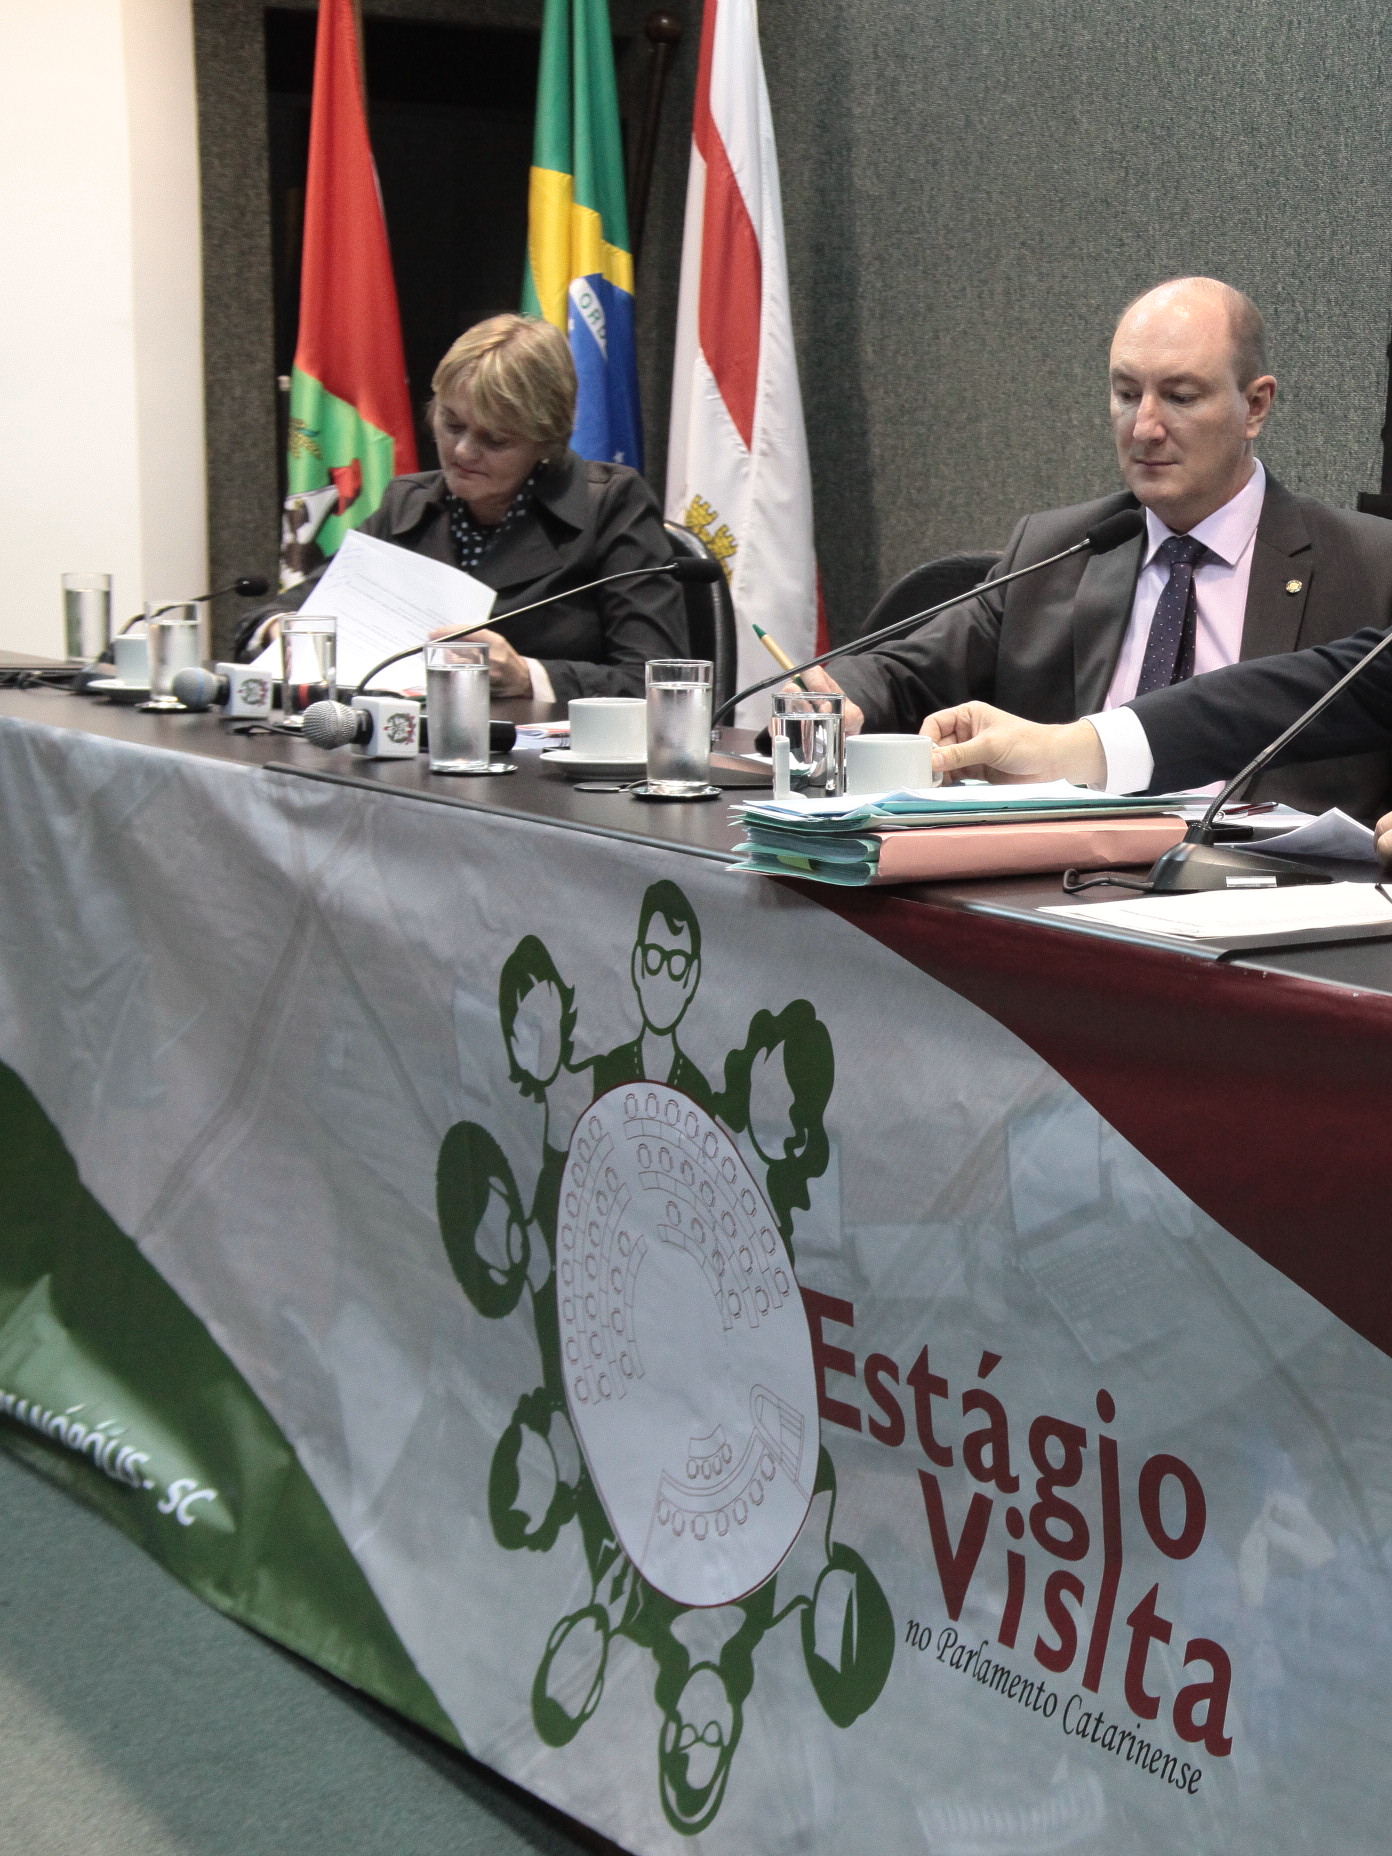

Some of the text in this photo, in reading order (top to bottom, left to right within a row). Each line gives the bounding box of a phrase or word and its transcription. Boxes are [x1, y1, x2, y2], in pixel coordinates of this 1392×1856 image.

[800, 1286, 1208, 1563] Estágio
[905, 1618, 1203, 1796] no Parlamento Catarinense
